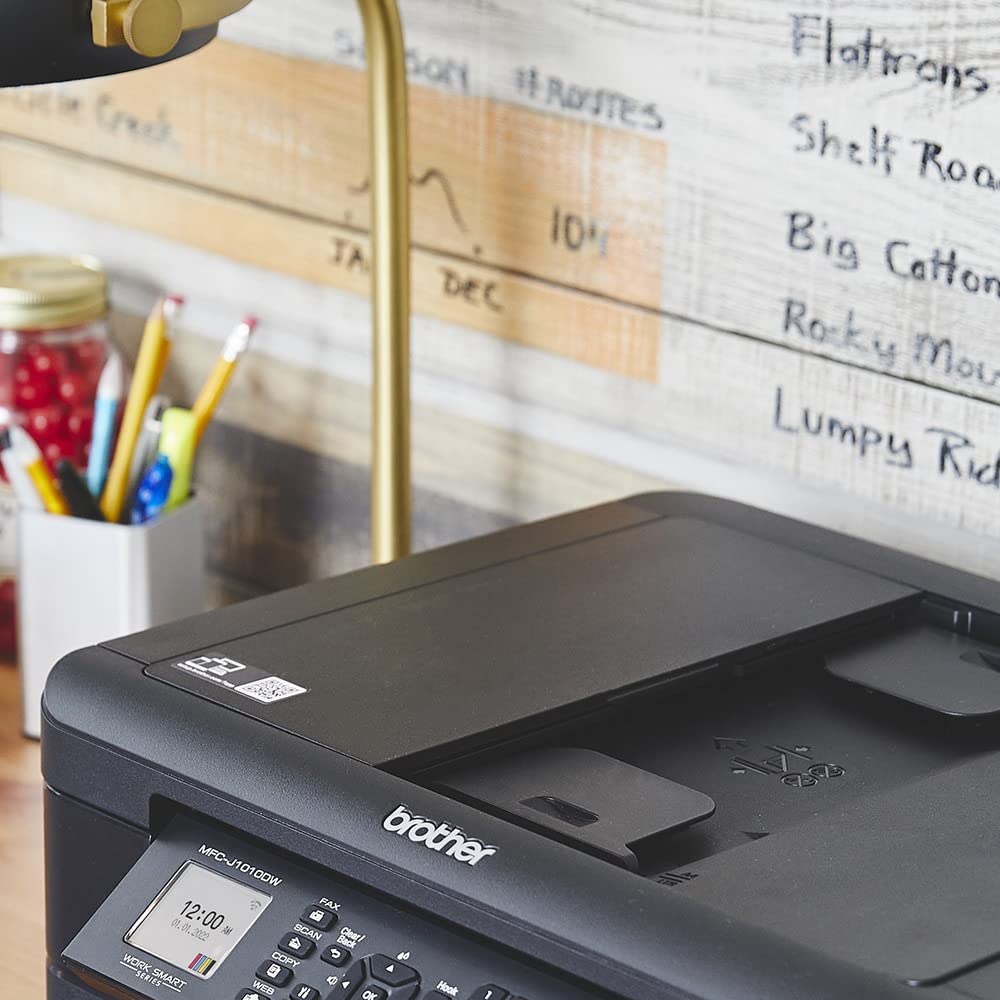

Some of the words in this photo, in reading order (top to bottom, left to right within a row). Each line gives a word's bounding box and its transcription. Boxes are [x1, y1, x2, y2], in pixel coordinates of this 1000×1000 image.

[788, 113, 900, 175] Shelf
[329, 237, 370, 274] JA
[784, 211, 859, 271] Big
[782, 298, 898, 367] Rocky
[773, 385, 914, 469] Lumpy
[383, 804, 498, 867] brother
[198, 844, 283, 887] MFC-J1010DW
[179, 900, 226, 930] 12:00
[319, 897, 342, 912] FAX
[293, 923, 323, 941] SCAN
[336, 935, 357, 950] Back
[122, 953, 153, 973] WORK
[151, 968, 188, 989] SMART
[271, 951, 301, 968] COPY
[135, 970, 162, 988] SERIES
[252, 979, 276, 996] WEB
[436, 980, 459, 997] Hook
[483, 990, 493, 1000] 1
